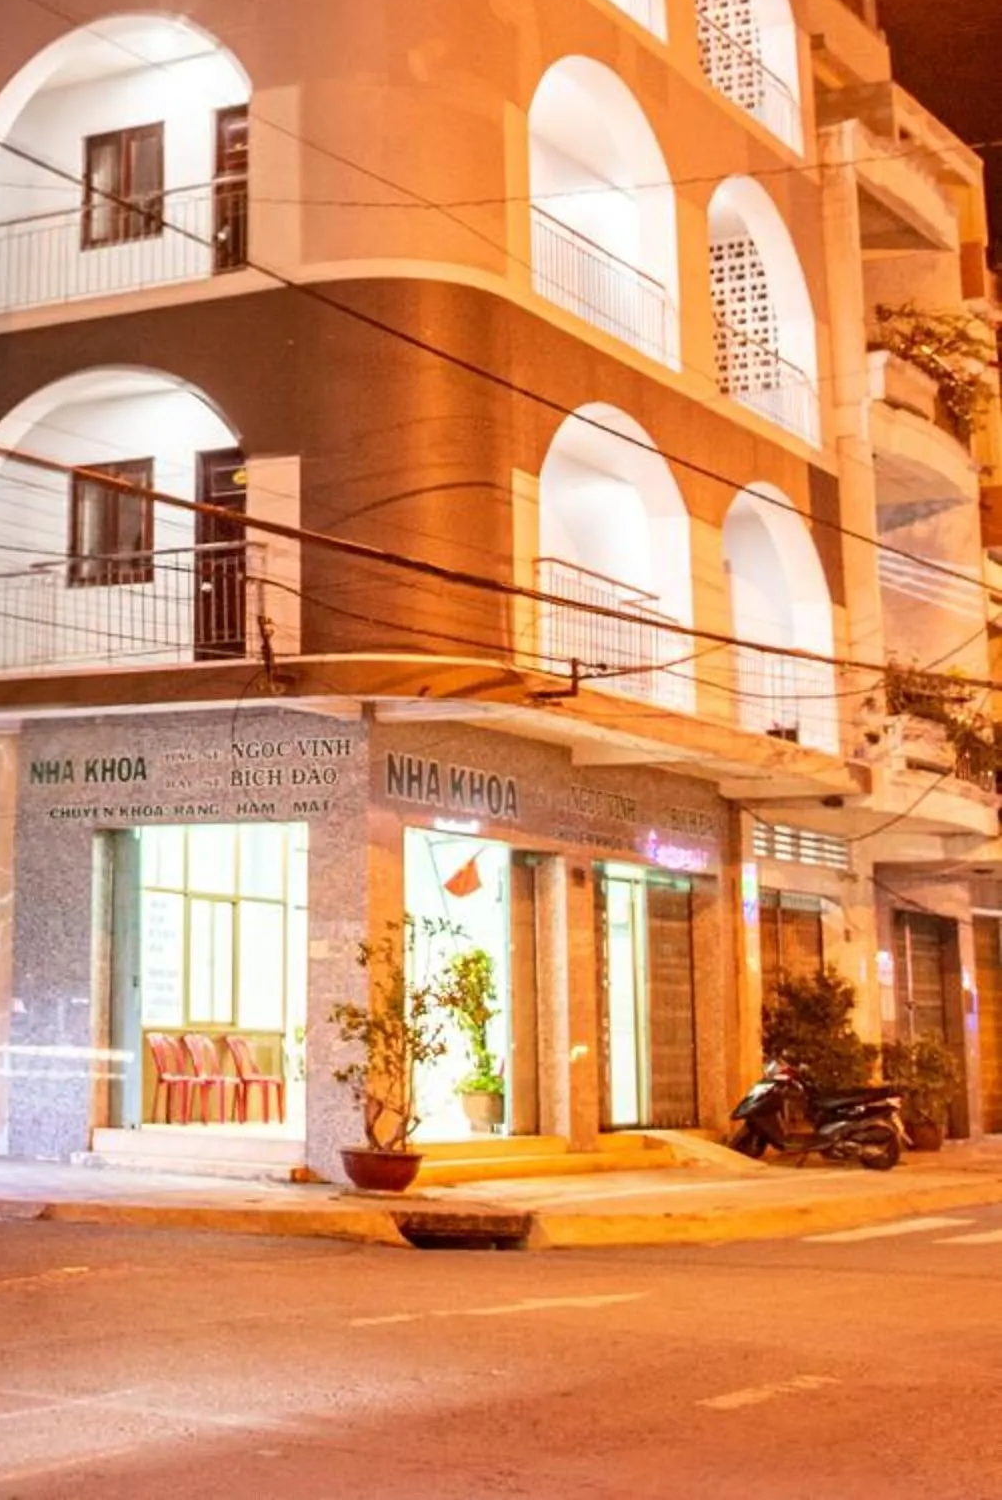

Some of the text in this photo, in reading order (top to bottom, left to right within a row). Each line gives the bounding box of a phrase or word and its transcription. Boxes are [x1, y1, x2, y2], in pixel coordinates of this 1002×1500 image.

[30, 759, 75, 785] NHA
[84, 755, 147, 783] KHOA
[386, 752, 441, 802] NHA
[450, 766, 519, 820] KHOA
